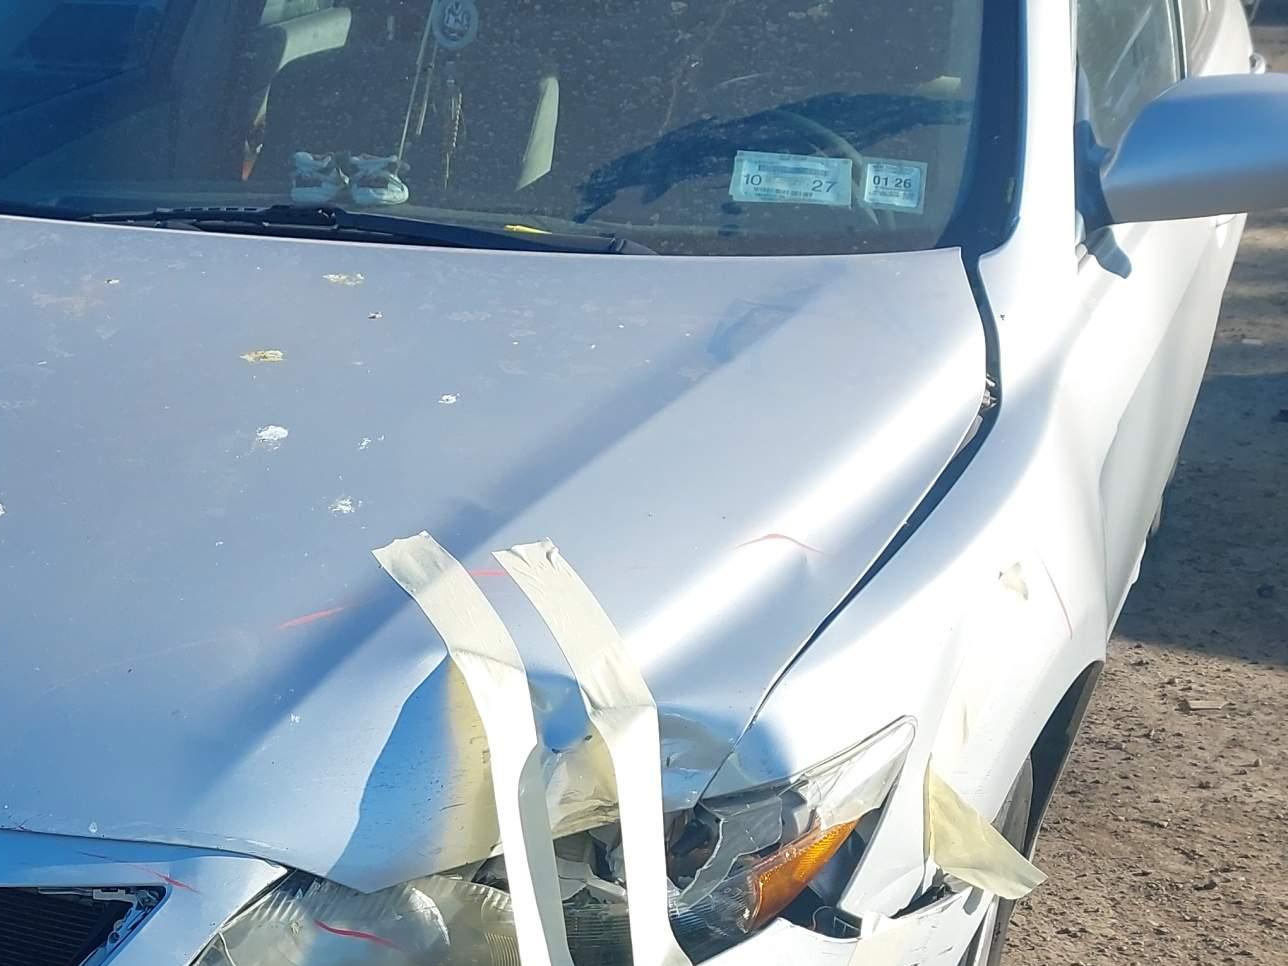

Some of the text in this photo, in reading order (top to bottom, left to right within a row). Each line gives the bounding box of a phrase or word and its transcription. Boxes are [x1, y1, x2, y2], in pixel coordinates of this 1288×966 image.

[743, 174, 762, 186] 10
[811, 179, 838, 193] 27
[872, 175, 912, 189] 01 26
